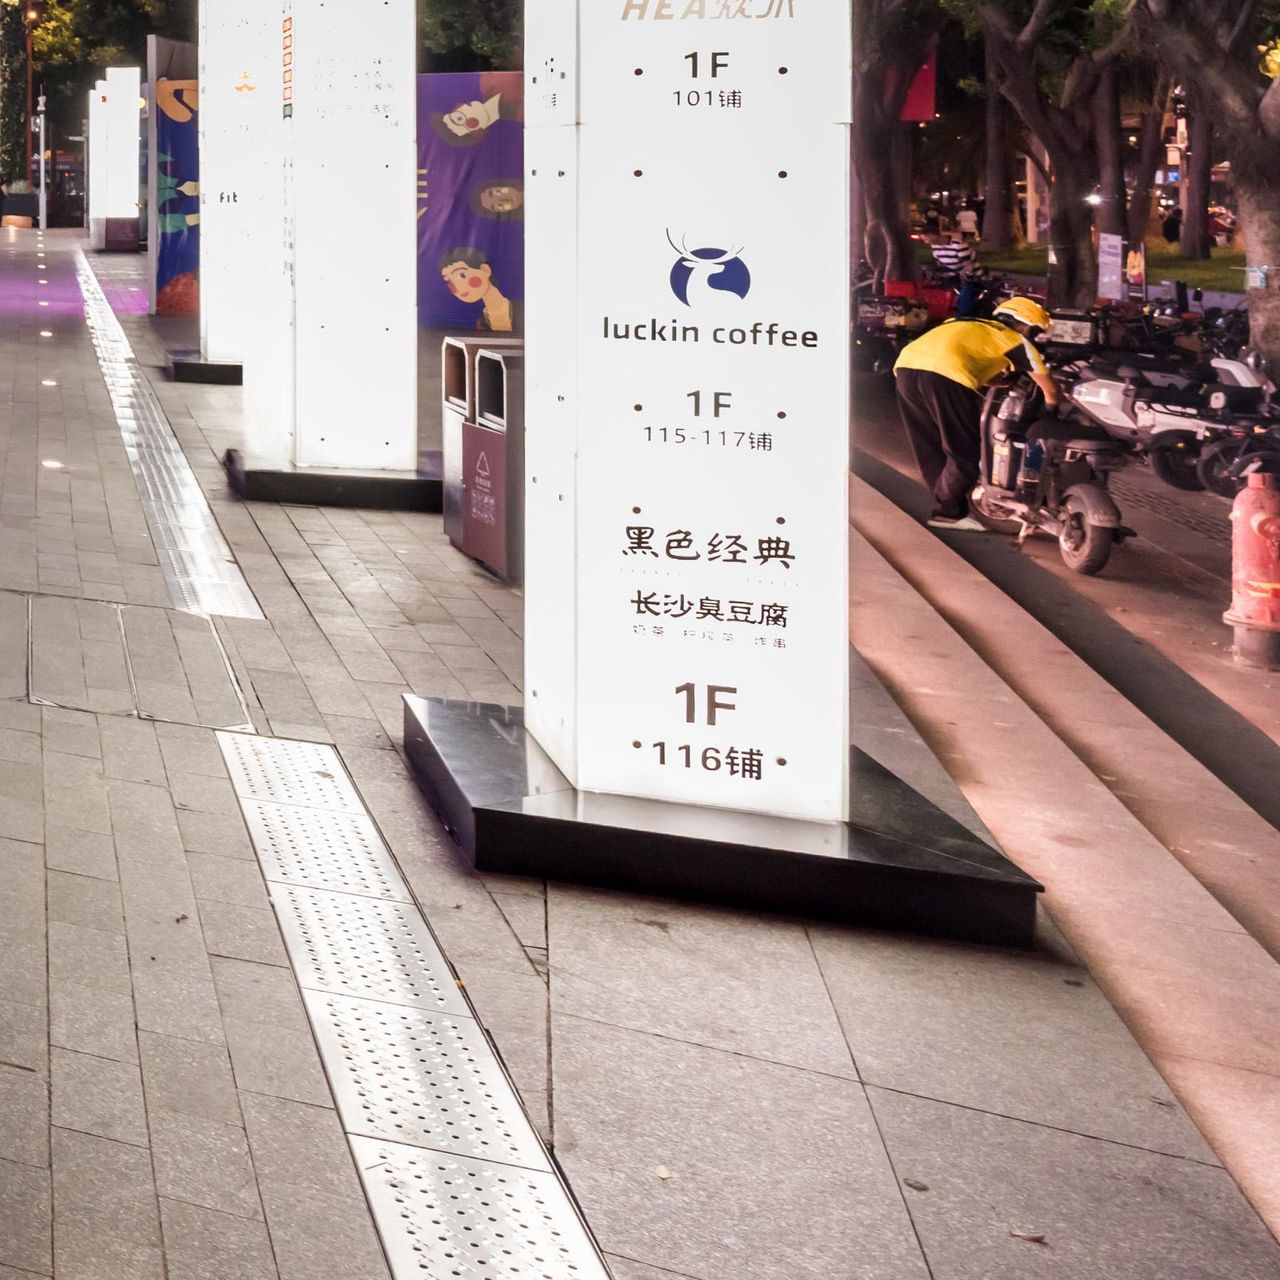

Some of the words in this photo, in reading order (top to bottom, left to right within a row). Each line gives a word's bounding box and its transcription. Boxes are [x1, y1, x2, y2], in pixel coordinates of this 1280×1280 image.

[684, 51, 730, 78] 1F
[672, 89, 743, 108] 101铺
[603, 316, 700, 343] luckin
[712, 322, 819, 348] coffee
[686, 389, 733, 418] 1F
[643, 425, 773, 451] 115-117铺
[621, 525, 797, 570] 黑色经典
[630, 589, 789, 628] 长沙臭豆腐
[675, 681, 738, 727] 1F
[652, 740, 764, 782] 116铺
